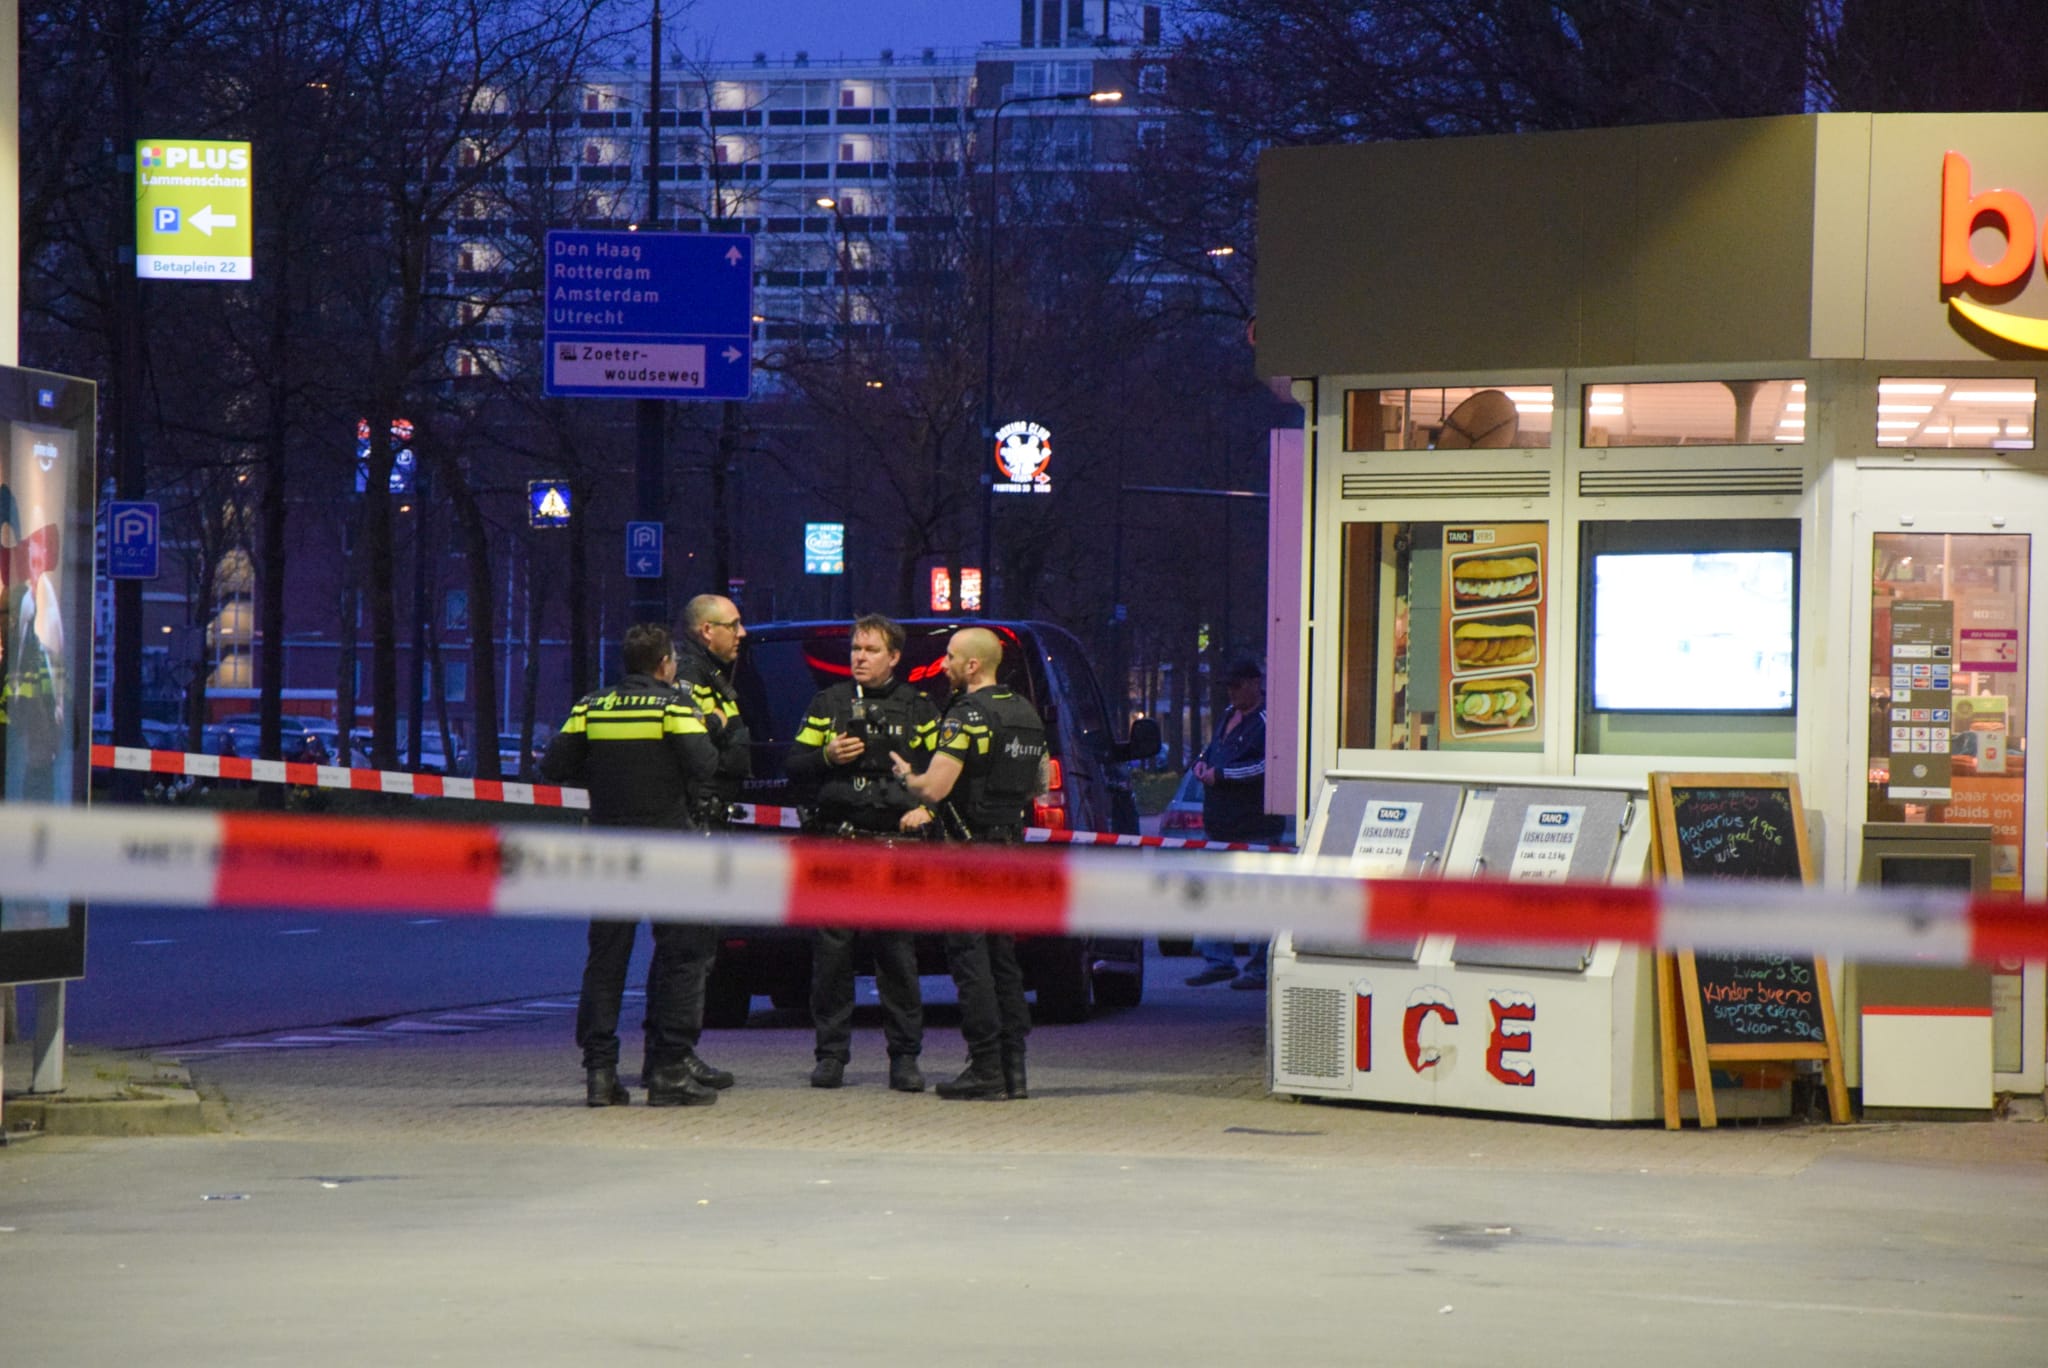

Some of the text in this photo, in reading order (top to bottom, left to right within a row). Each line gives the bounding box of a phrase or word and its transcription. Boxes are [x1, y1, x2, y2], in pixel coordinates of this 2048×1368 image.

[166, 147, 248, 170] PLUS
[142, 173, 248, 188] Lammenschans
[555, 241, 641, 260] Den Haag
[153, 260, 236, 274] Betaplein 22
[554, 264, 650, 280] Rotterdam
[555, 286, 659, 303] Amsterdam
[553, 308, 624, 324] Utrecht
[582, 347, 648, 361] Zoeter-
[605, 367, 699, 385] woudseweg
[597, 690, 657, 711] POLITIE
[743, 778, 790, 790] EXPERT
[1944, 806, 2012, 821] plaids en
[1703, 981, 1812, 1006] Kinder bueno
[1355, 979, 1536, 1086] ICE
